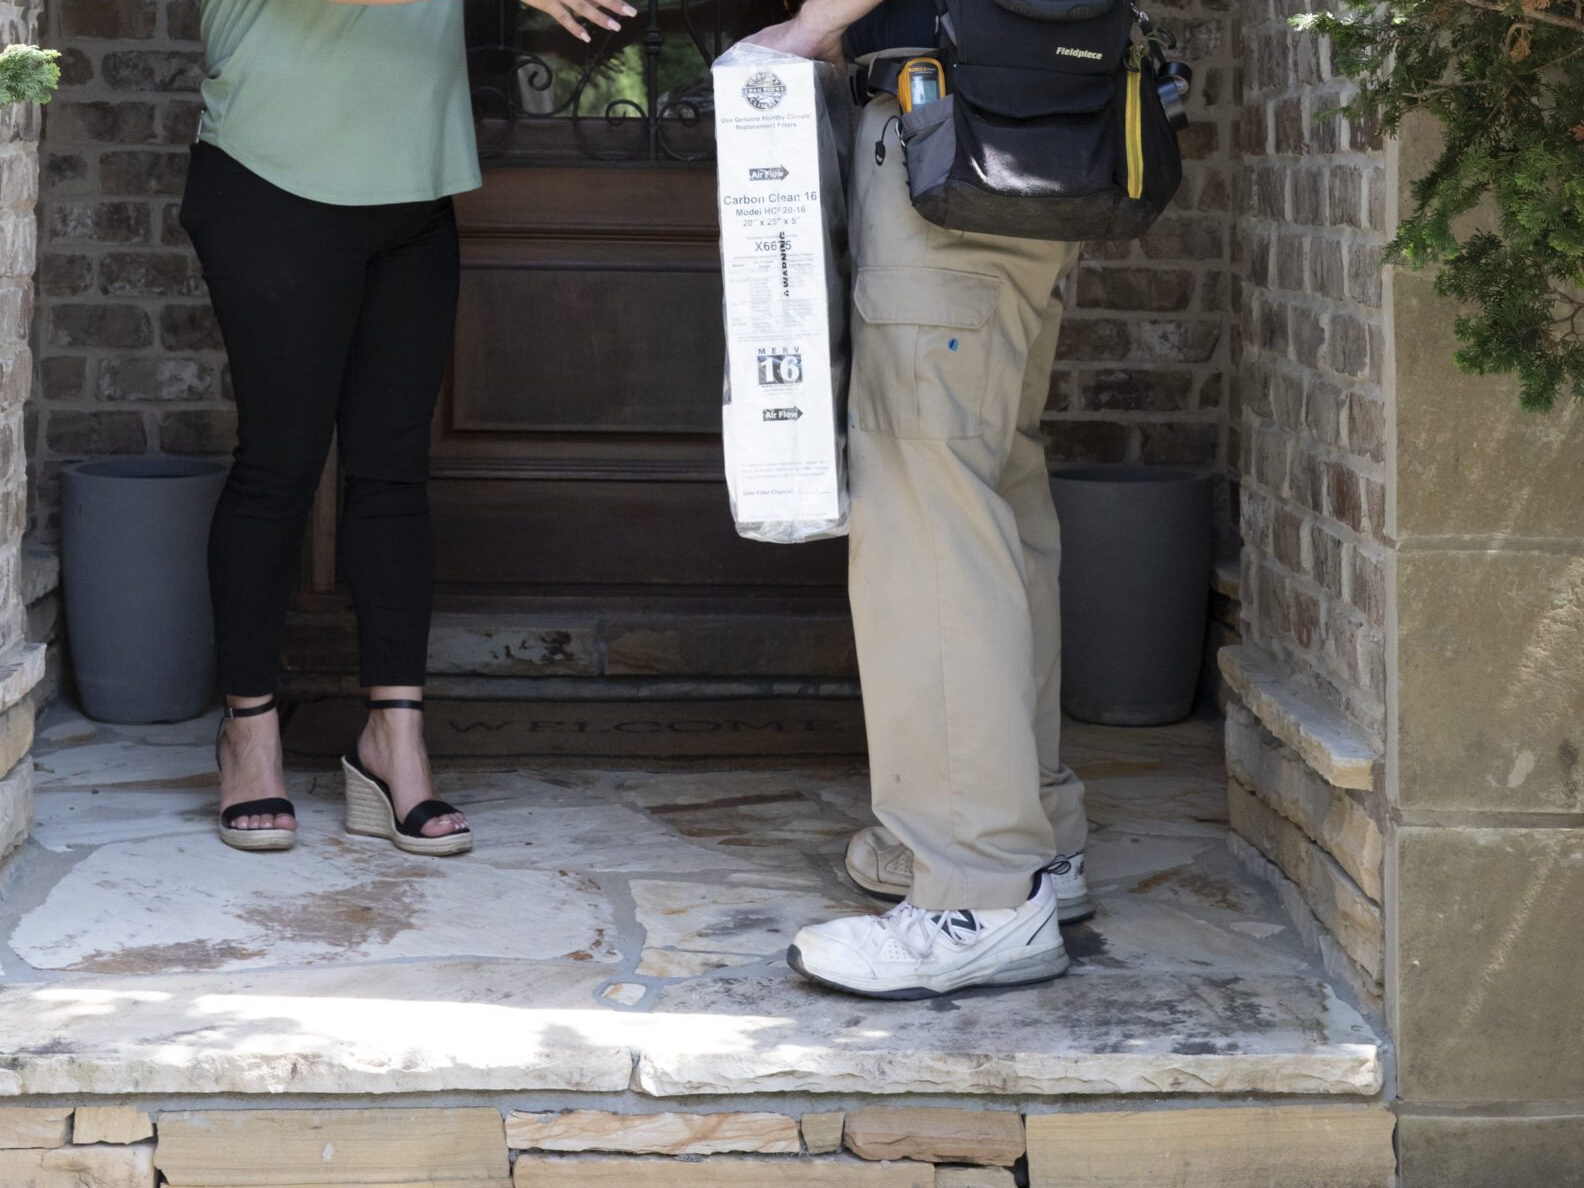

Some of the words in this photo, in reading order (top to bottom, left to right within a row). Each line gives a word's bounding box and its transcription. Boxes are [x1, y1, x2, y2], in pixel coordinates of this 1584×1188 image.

[1056, 46, 1103, 60] Fieldpiece
[751, 171, 763, 179] Air
[765, 170, 784, 179] Flow
[723, 195, 765, 206] Carbon
[768, 193, 800, 203] Clean
[805, 191, 818, 201] 16
[735, 207, 762, 216] Model
[758, 346, 800, 355] MERV
[760, 356, 800, 382] 16
[765, 411, 776, 419] Air
[778, 411, 798, 419] Flow
[448, 719, 842, 734] WELCOME
